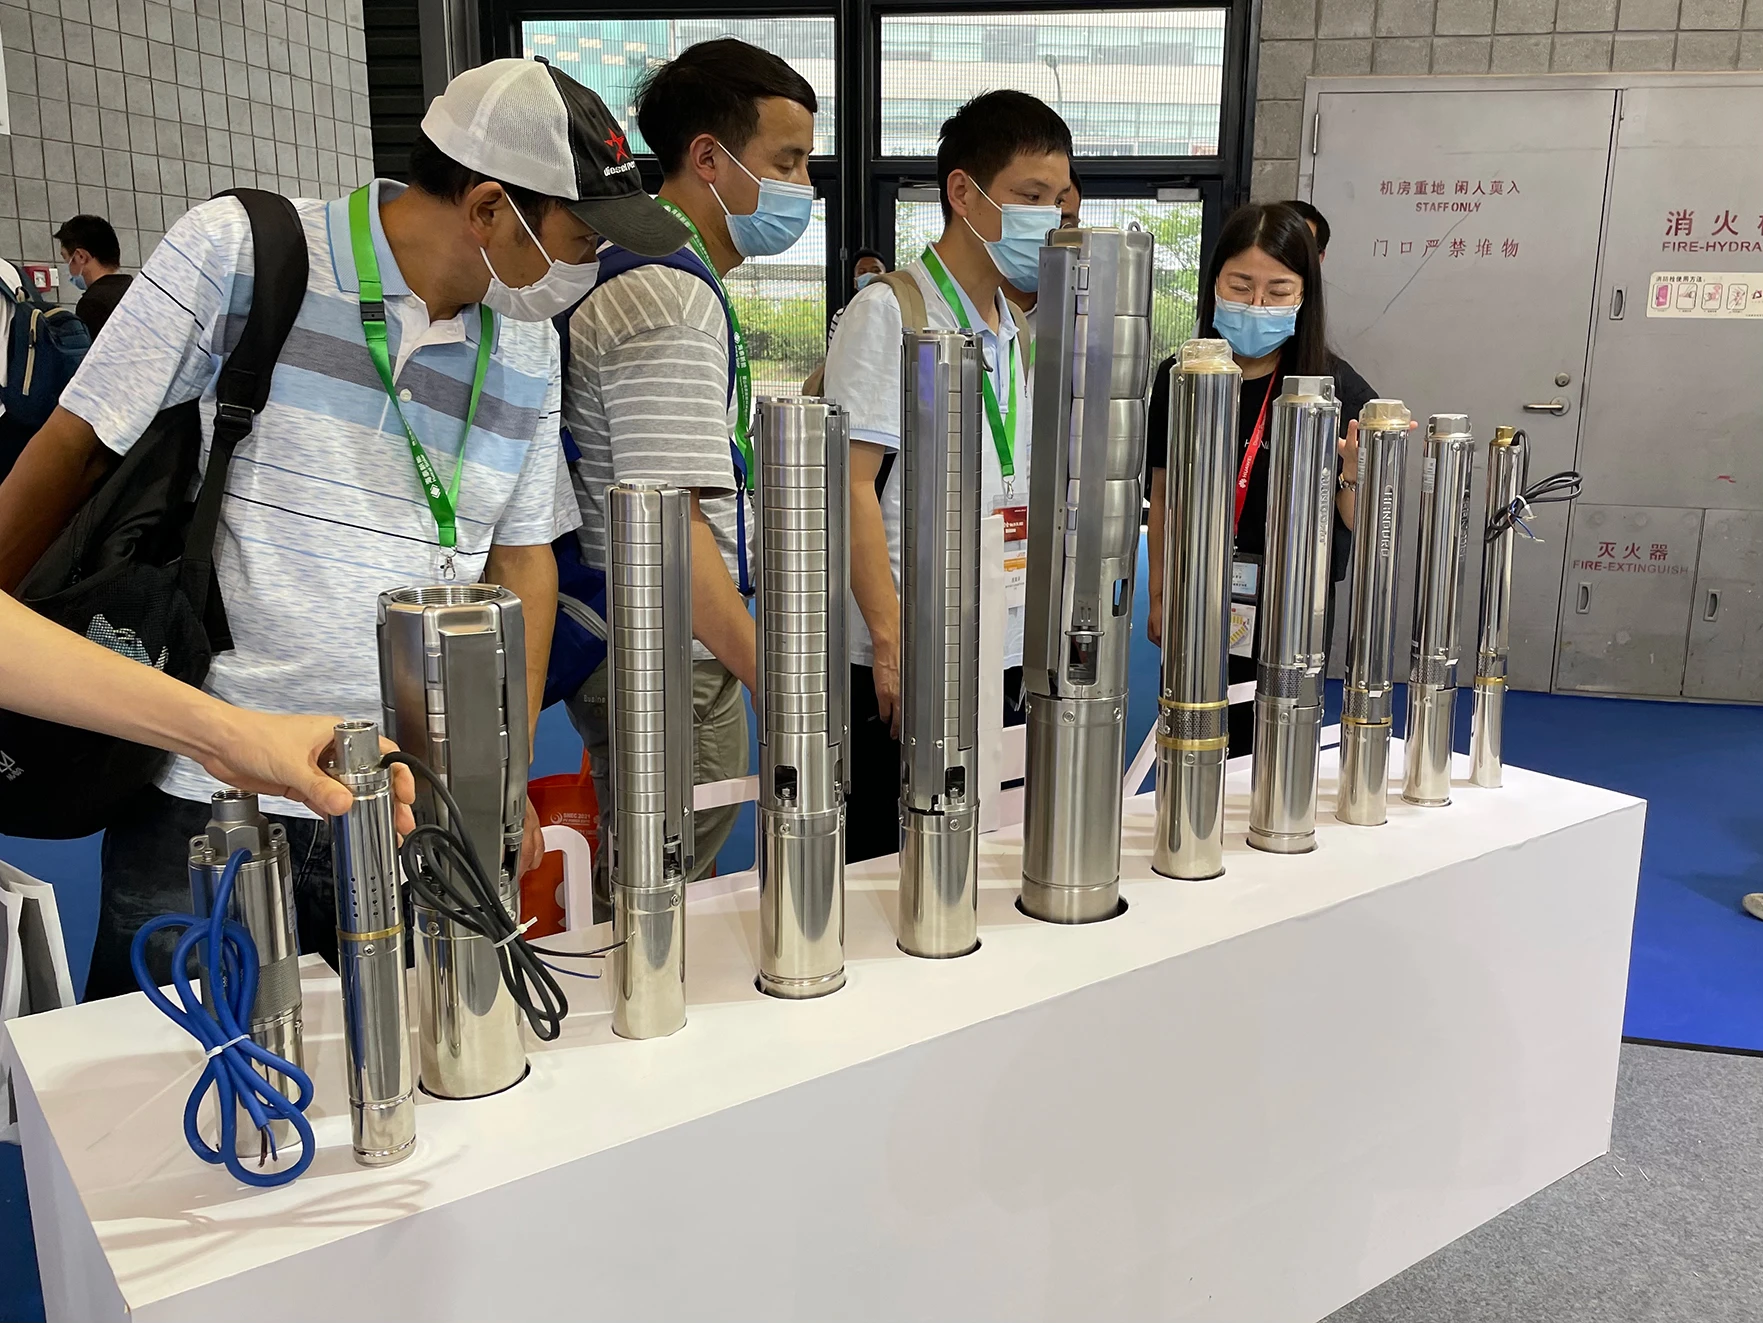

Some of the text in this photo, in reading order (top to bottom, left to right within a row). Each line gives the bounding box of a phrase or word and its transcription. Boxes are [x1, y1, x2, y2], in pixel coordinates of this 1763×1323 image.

[1380, 180, 1445, 195] 机房重地
[1416, 202, 1481, 212] STAFF ONLY
[1372, 238, 1519, 258] 门口严禁堆物
[1243, 455, 1252, 478] HUAWEI
[1597, 541, 1668, 561] 灭火器
[1573, 560, 1689, 575] FIRE-EXTINGUISH
